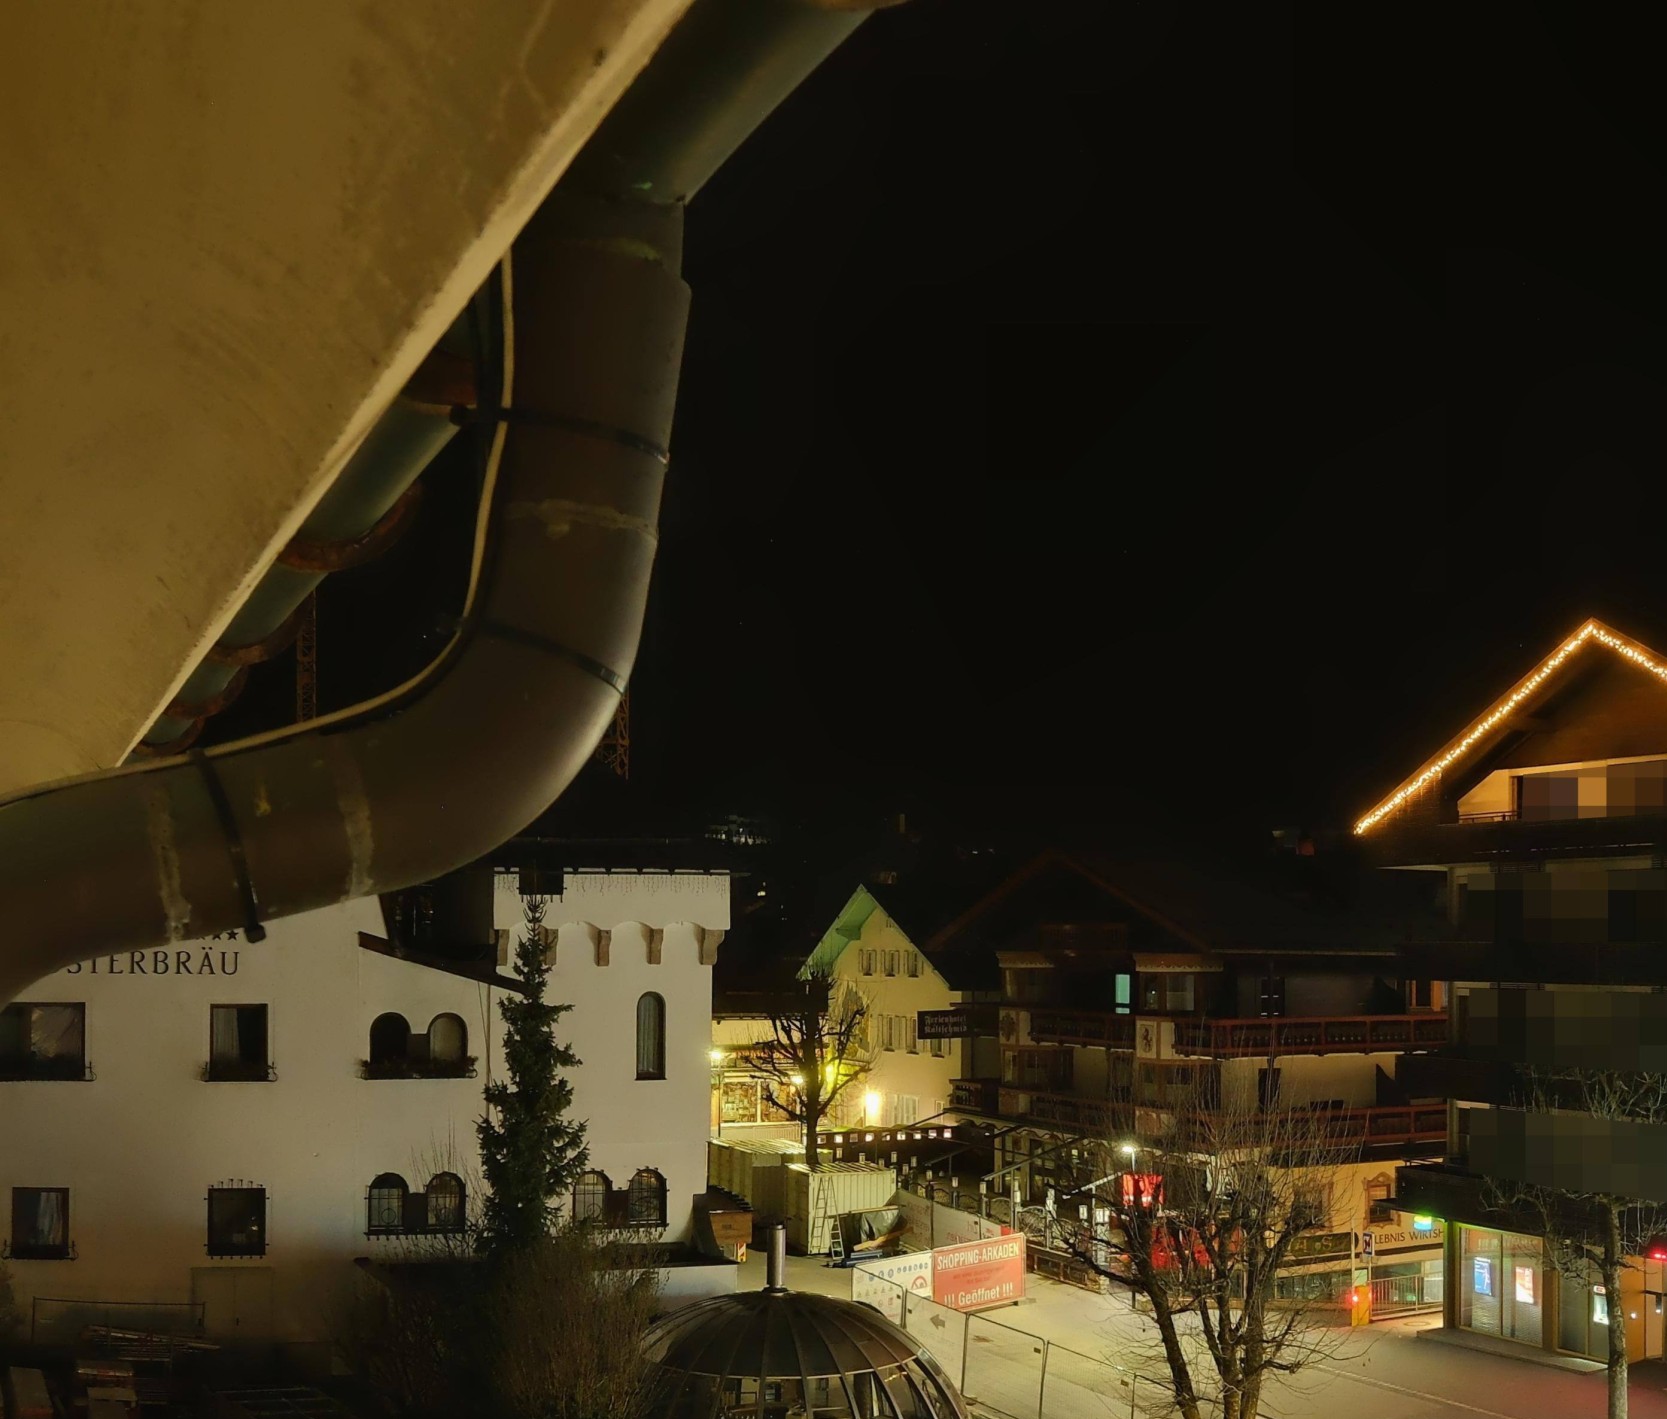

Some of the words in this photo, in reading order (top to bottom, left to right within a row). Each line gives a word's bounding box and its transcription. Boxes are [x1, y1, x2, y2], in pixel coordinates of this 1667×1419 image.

[67, 947, 240, 976] STERBRÄU
[1374, 1231, 1405, 1245] LEBNIS
[936, 1242, 1019, 1271] SHOPPING-ARKADEN
[958, 1289, 1000, 1306] Geöffnet
